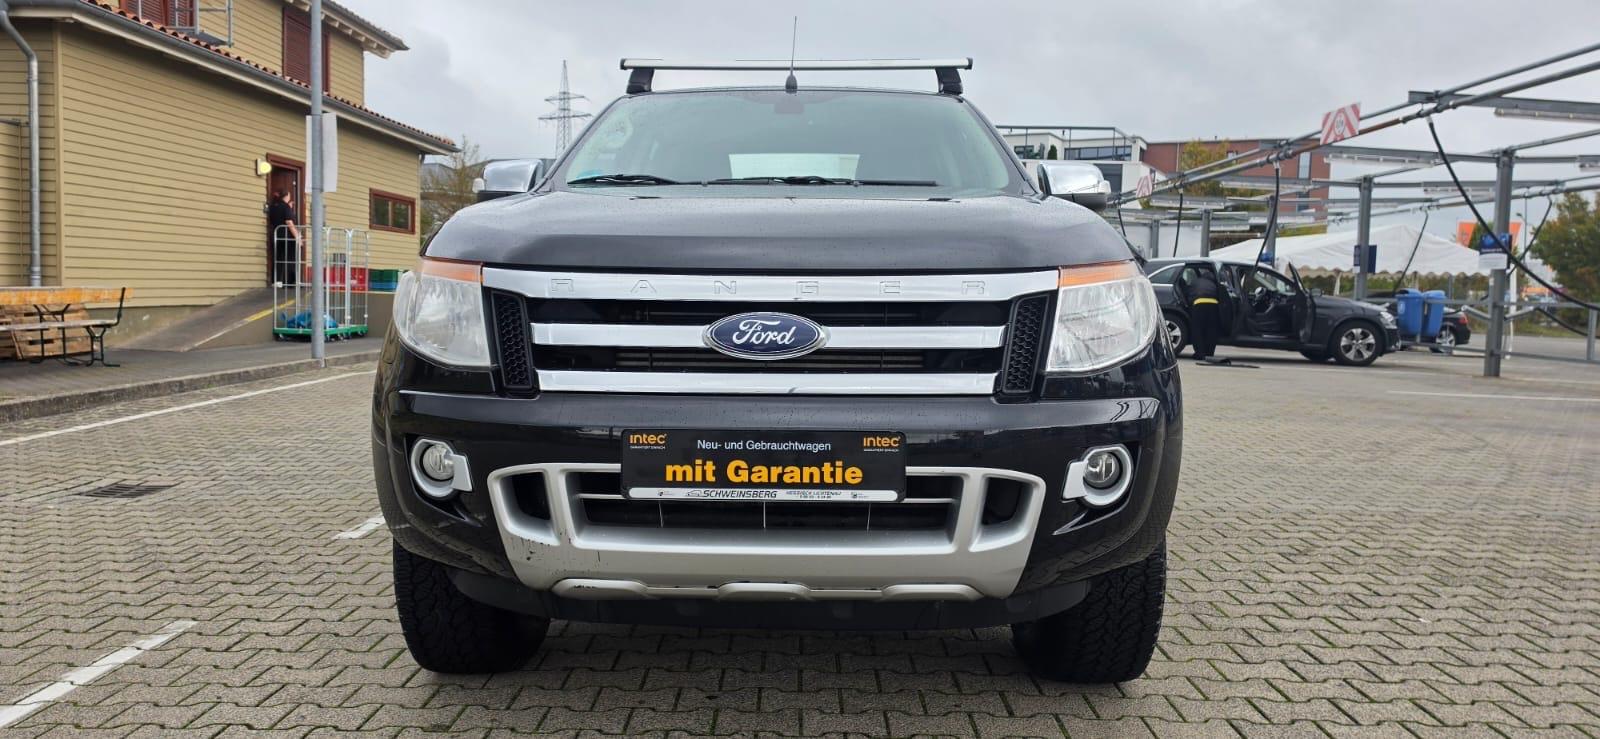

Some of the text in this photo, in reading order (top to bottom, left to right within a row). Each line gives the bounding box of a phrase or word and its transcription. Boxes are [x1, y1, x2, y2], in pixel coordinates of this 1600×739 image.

[551, 277, 987, 297] RANGER
[732, 319, 797, 344] Ford
[629, 433, 667, 444] intec
[864, 436, 900, 447] intec
[697, 440, 831, 452] Neu- und Gebrauchtwagen
[665, 459, 863, 484] mit Garantie
[703, 489, 778, 499] SCHWEINSBERG
